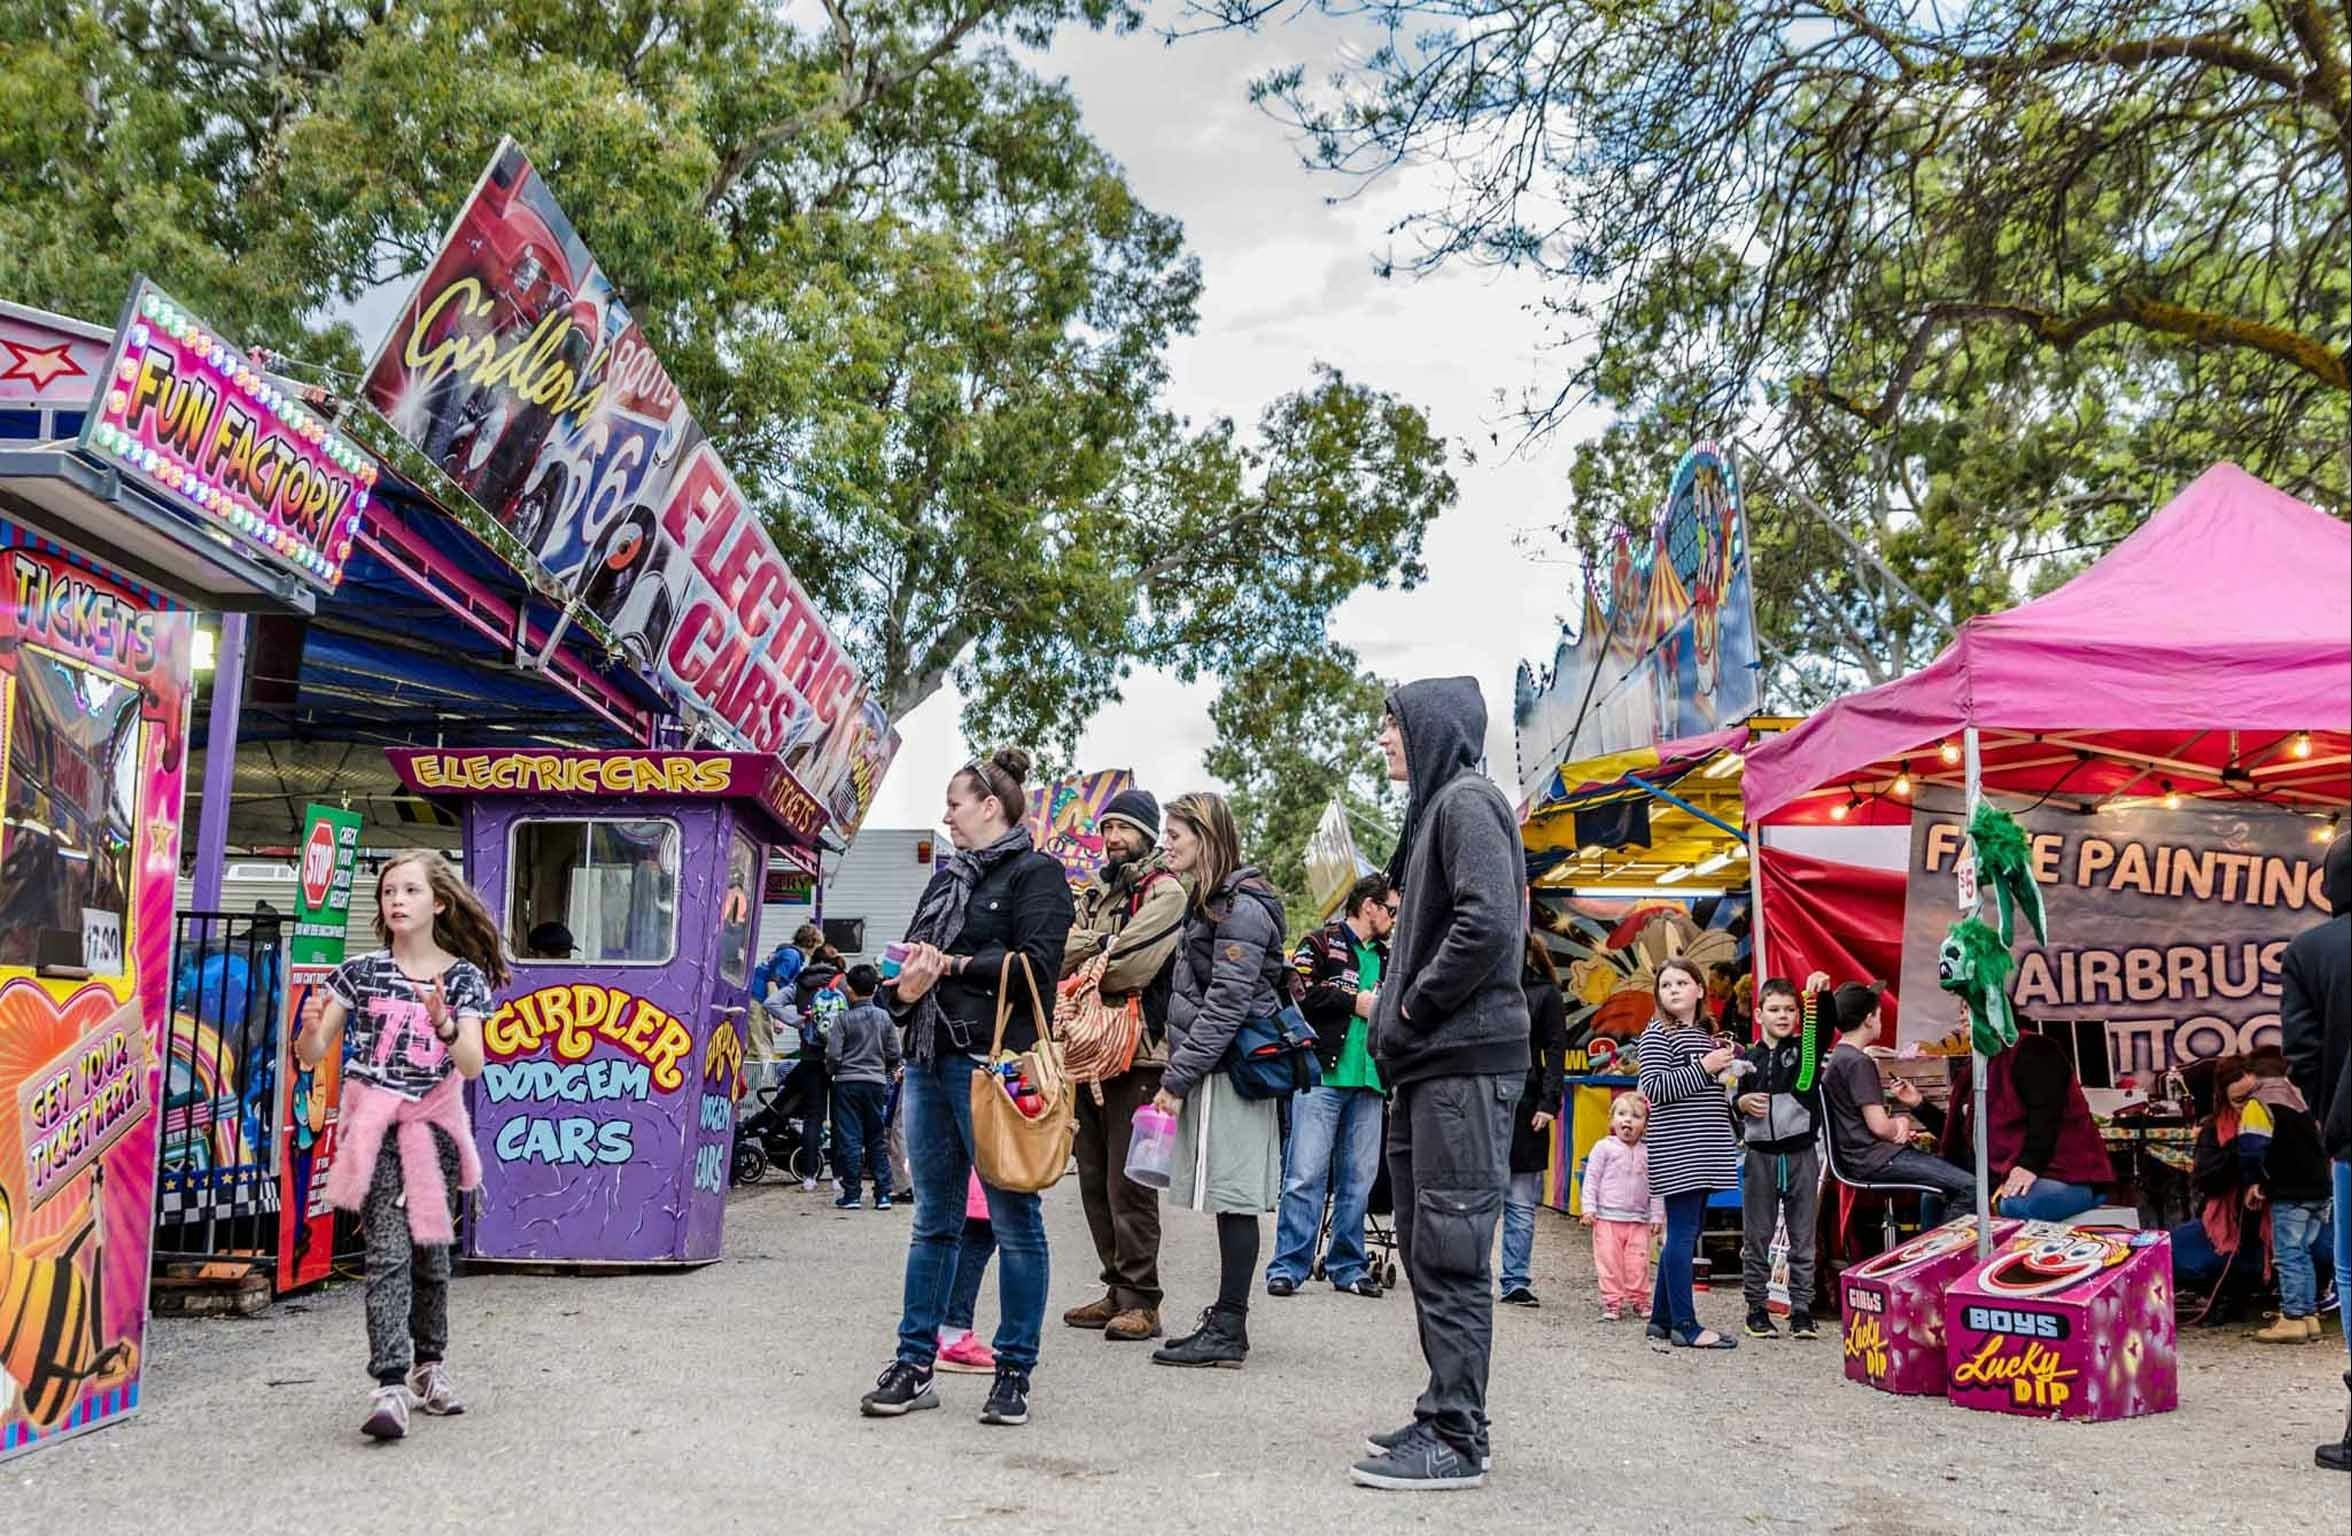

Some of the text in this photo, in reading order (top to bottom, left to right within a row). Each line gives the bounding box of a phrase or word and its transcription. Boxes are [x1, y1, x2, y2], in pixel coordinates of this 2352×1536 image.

[127, 346, 351, 553] FUN FACTORY
[13, 553, 155, 674] TICKETS
[661, 452, 857, 725] ELECTRIC
[667, 602, 795, 753] CARS
[774, 776, 817, 834] TICKETS
[306, 842, 334, 888] STOP
[1925, 823, 2064, 884] FE
[2013, 940, 2284, 1007] AIRBRUS
[485, 985, 691, 1089] GIRDLER
[705, 1020, 744, 1104] GIRDLER
[32, 1031, 128, 1129] GET YOUR
[482, 1060, 650, 1102] DODGEM
[32, 1064, 142, 1188] TICKET HERE!
[700, 1094, 731, 1131] DODGEM
[496, 1115, 633, 1167] CARS
[695, 1144, 725, 1195] CARS
[1848, 1288, 1883, 1313] GIRLS
[1968, 1307, 2059, 1338] BOYS
[1844, 1311, 1889, 1357] Lucky
[1955, 1335, 2078, 1382] Lucky
[1866, 1348, 1888, 1378] DIP
[2014, 1378, 2071, 1406] DIP
